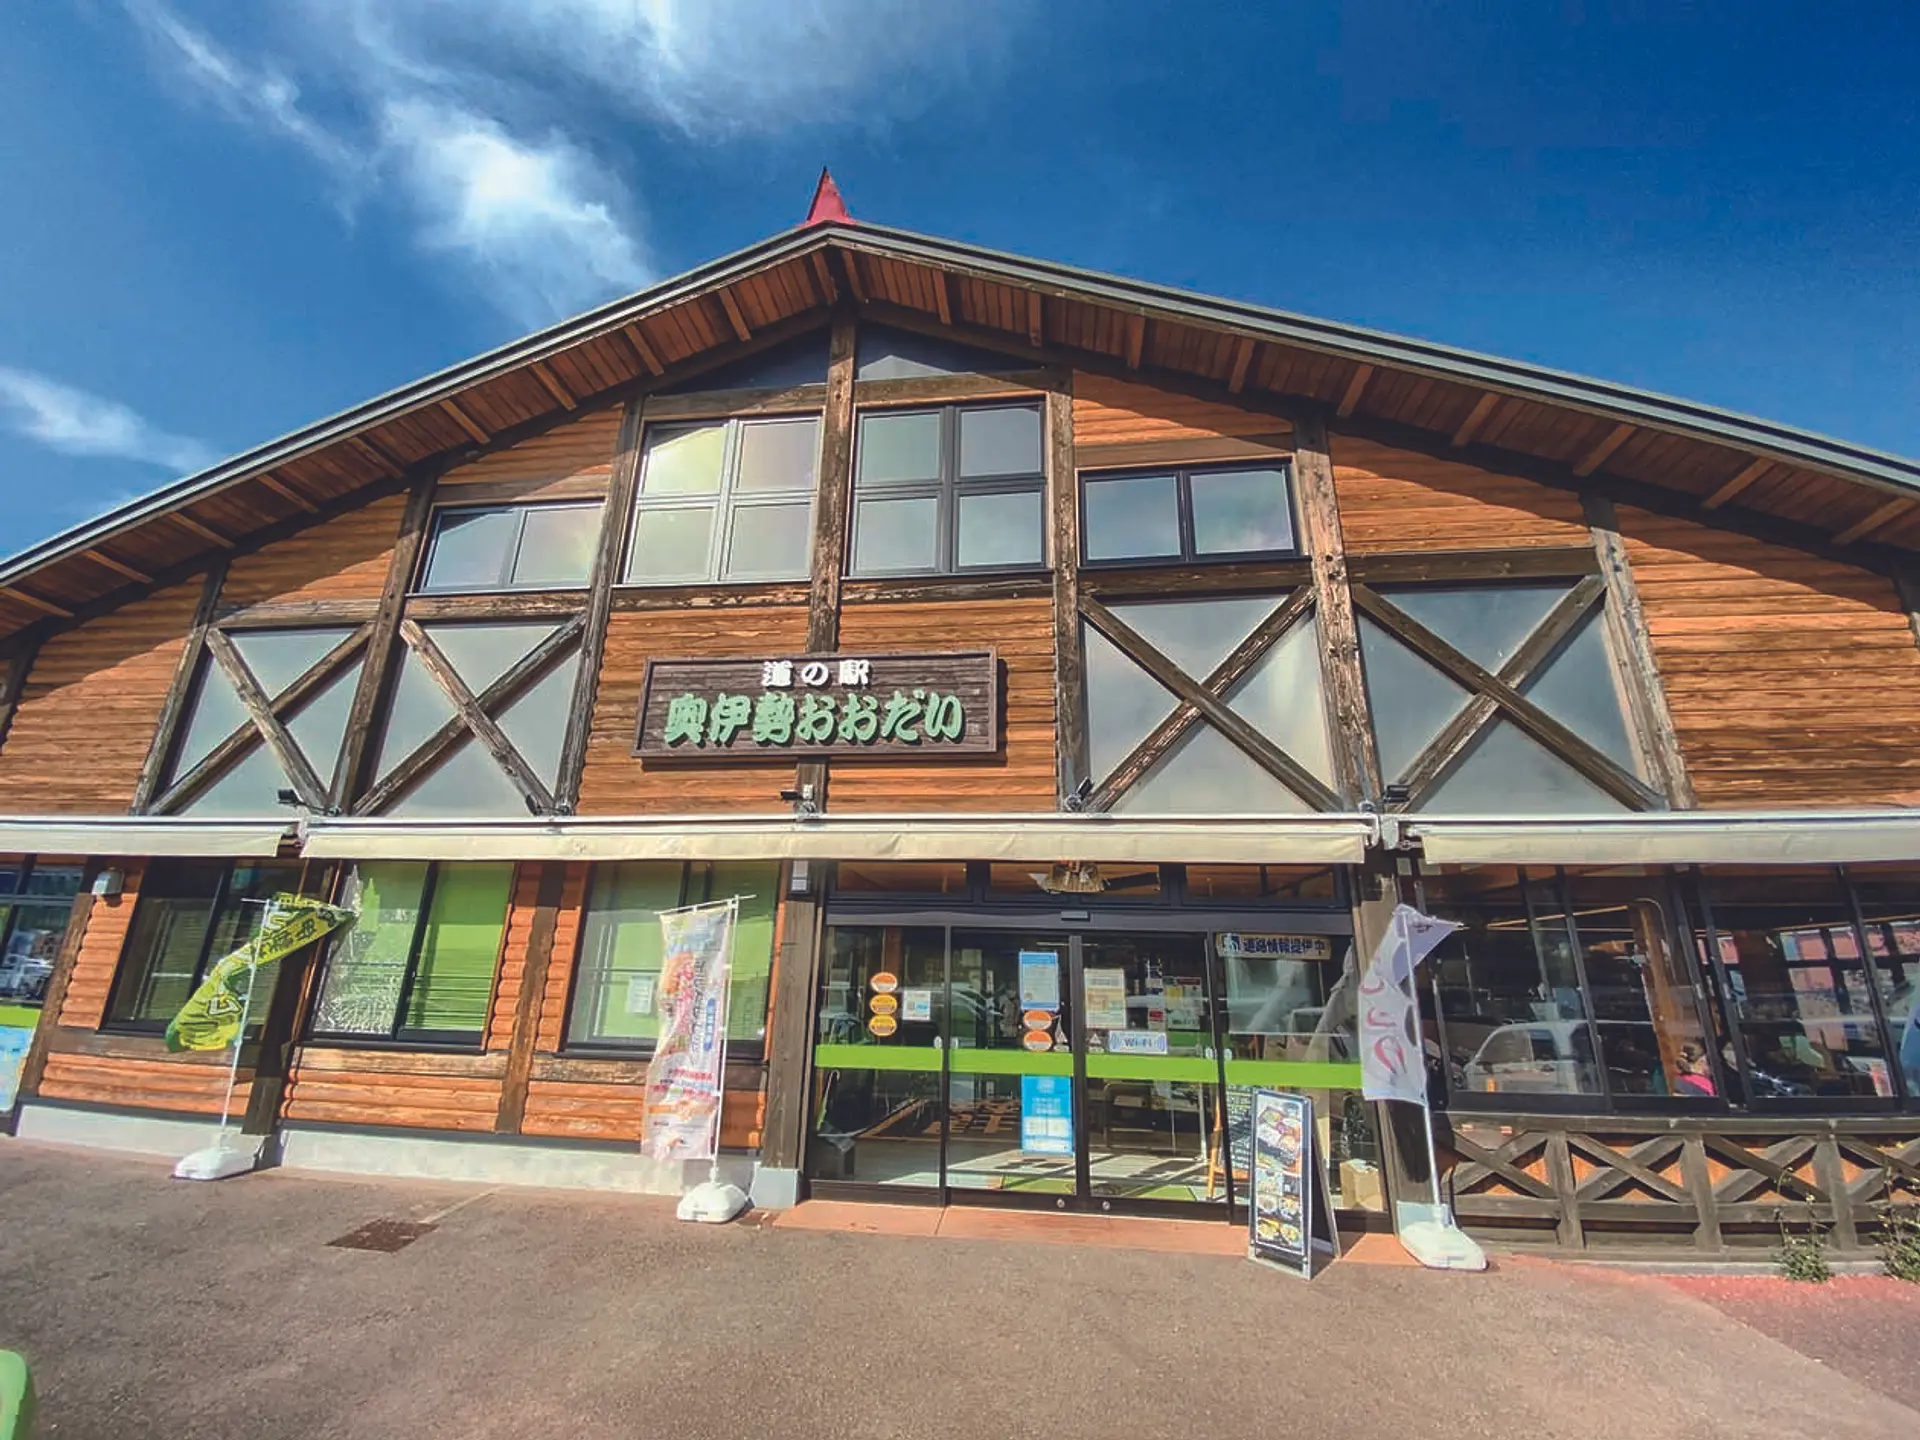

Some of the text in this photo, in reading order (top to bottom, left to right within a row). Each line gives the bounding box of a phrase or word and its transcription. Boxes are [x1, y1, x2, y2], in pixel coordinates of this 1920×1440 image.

[761, 659, 869, 687] 道の駅
[664, 690, 963, 745] 奥伊勢おおだい
